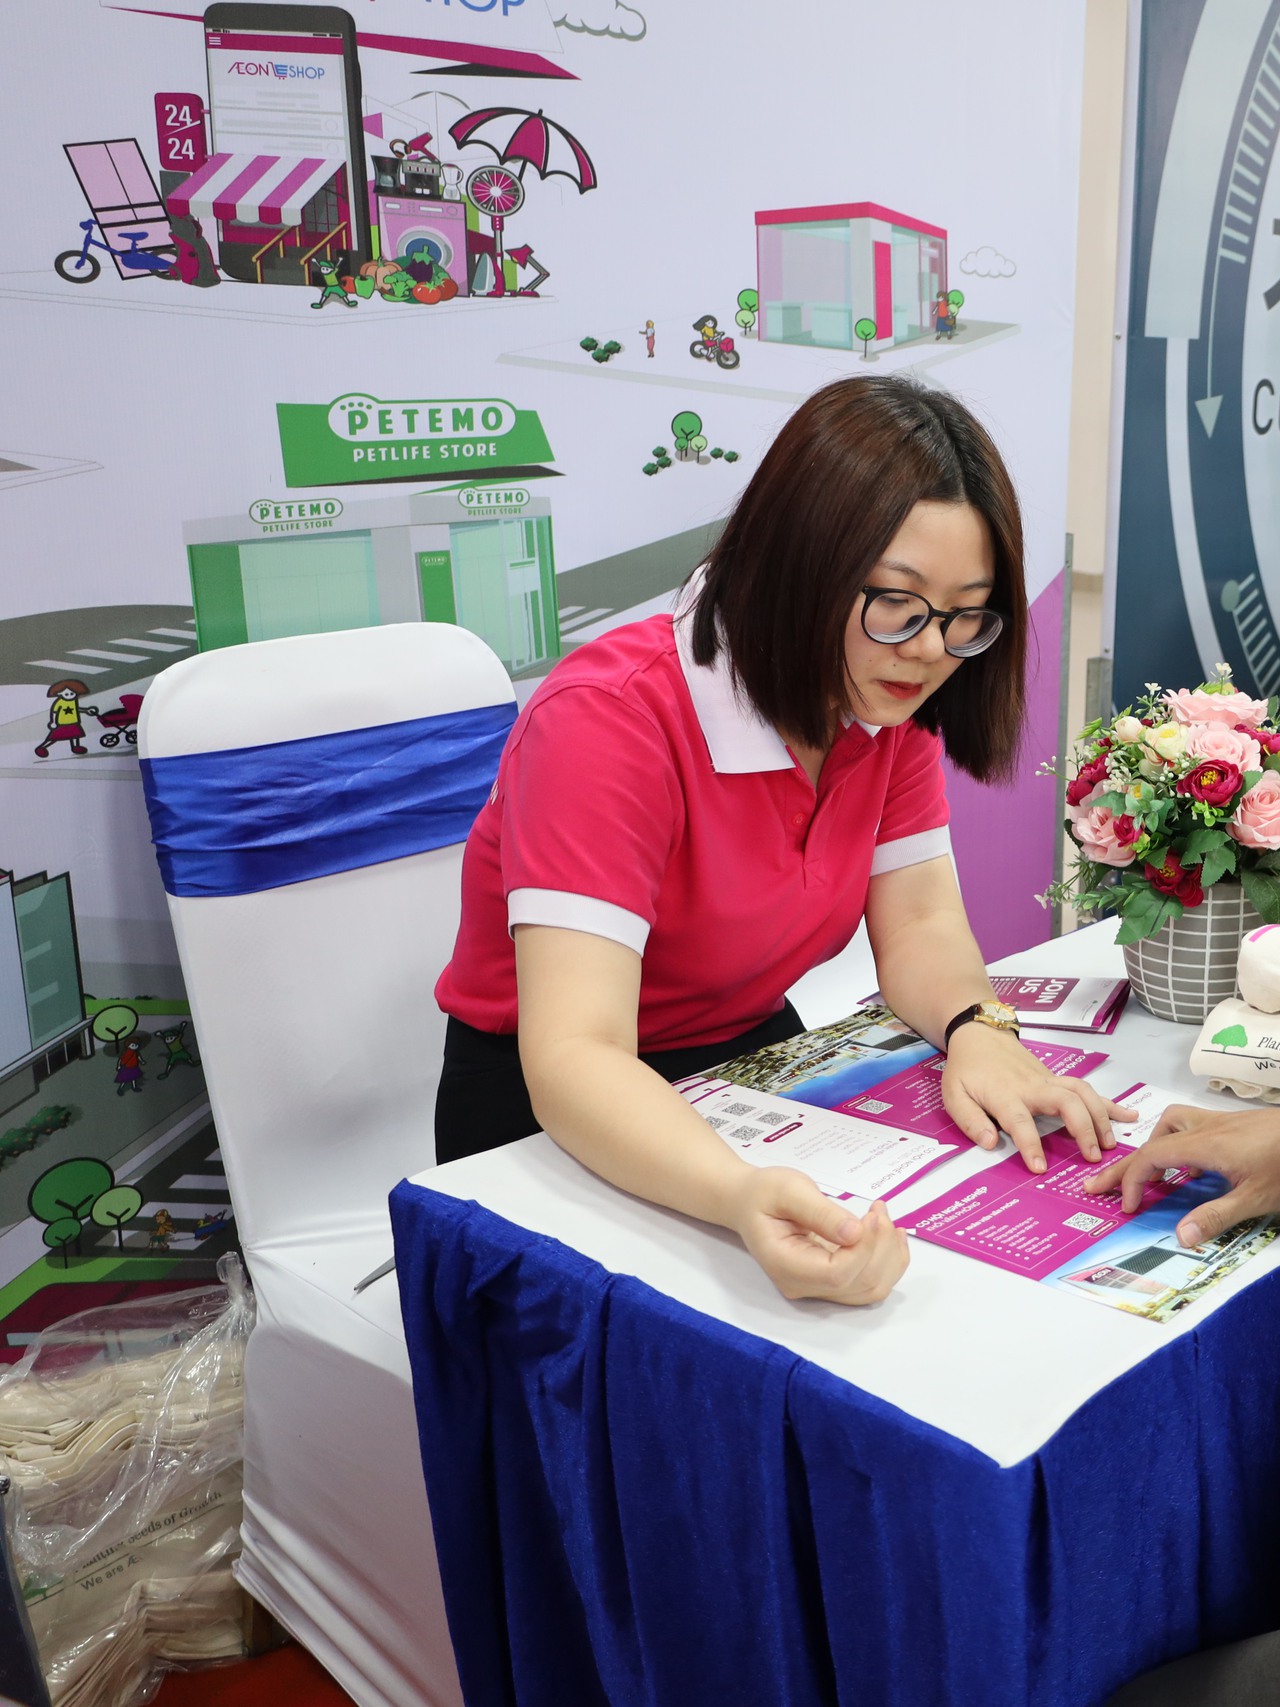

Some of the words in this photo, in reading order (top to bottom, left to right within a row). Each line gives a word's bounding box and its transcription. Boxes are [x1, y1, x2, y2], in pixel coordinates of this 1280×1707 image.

[165, 104, 192, 127] 24
[168, 138, 195, 160] 24
[347, 405, 503, 436] PETEMO
[353, 444, 431, 463] PETLIFE
[440, 442, 498, 458] STORE
[466, 491, 524, 505] PETEMO
[259, 501, 336, 521] PETEMO
[262, 521, 301, 533] PETLIFE
[304, 520, 333, 530] STORE
[1019, 979, 1044, 994] US
[1035, 979, 1067, 1004] JOIN
[1254, 1061, 1277, 1071] We
[164, 1511, 178, 1526] of
[81, 1576, 103, 1591] We
[106, 1565, 124, 1578] are
